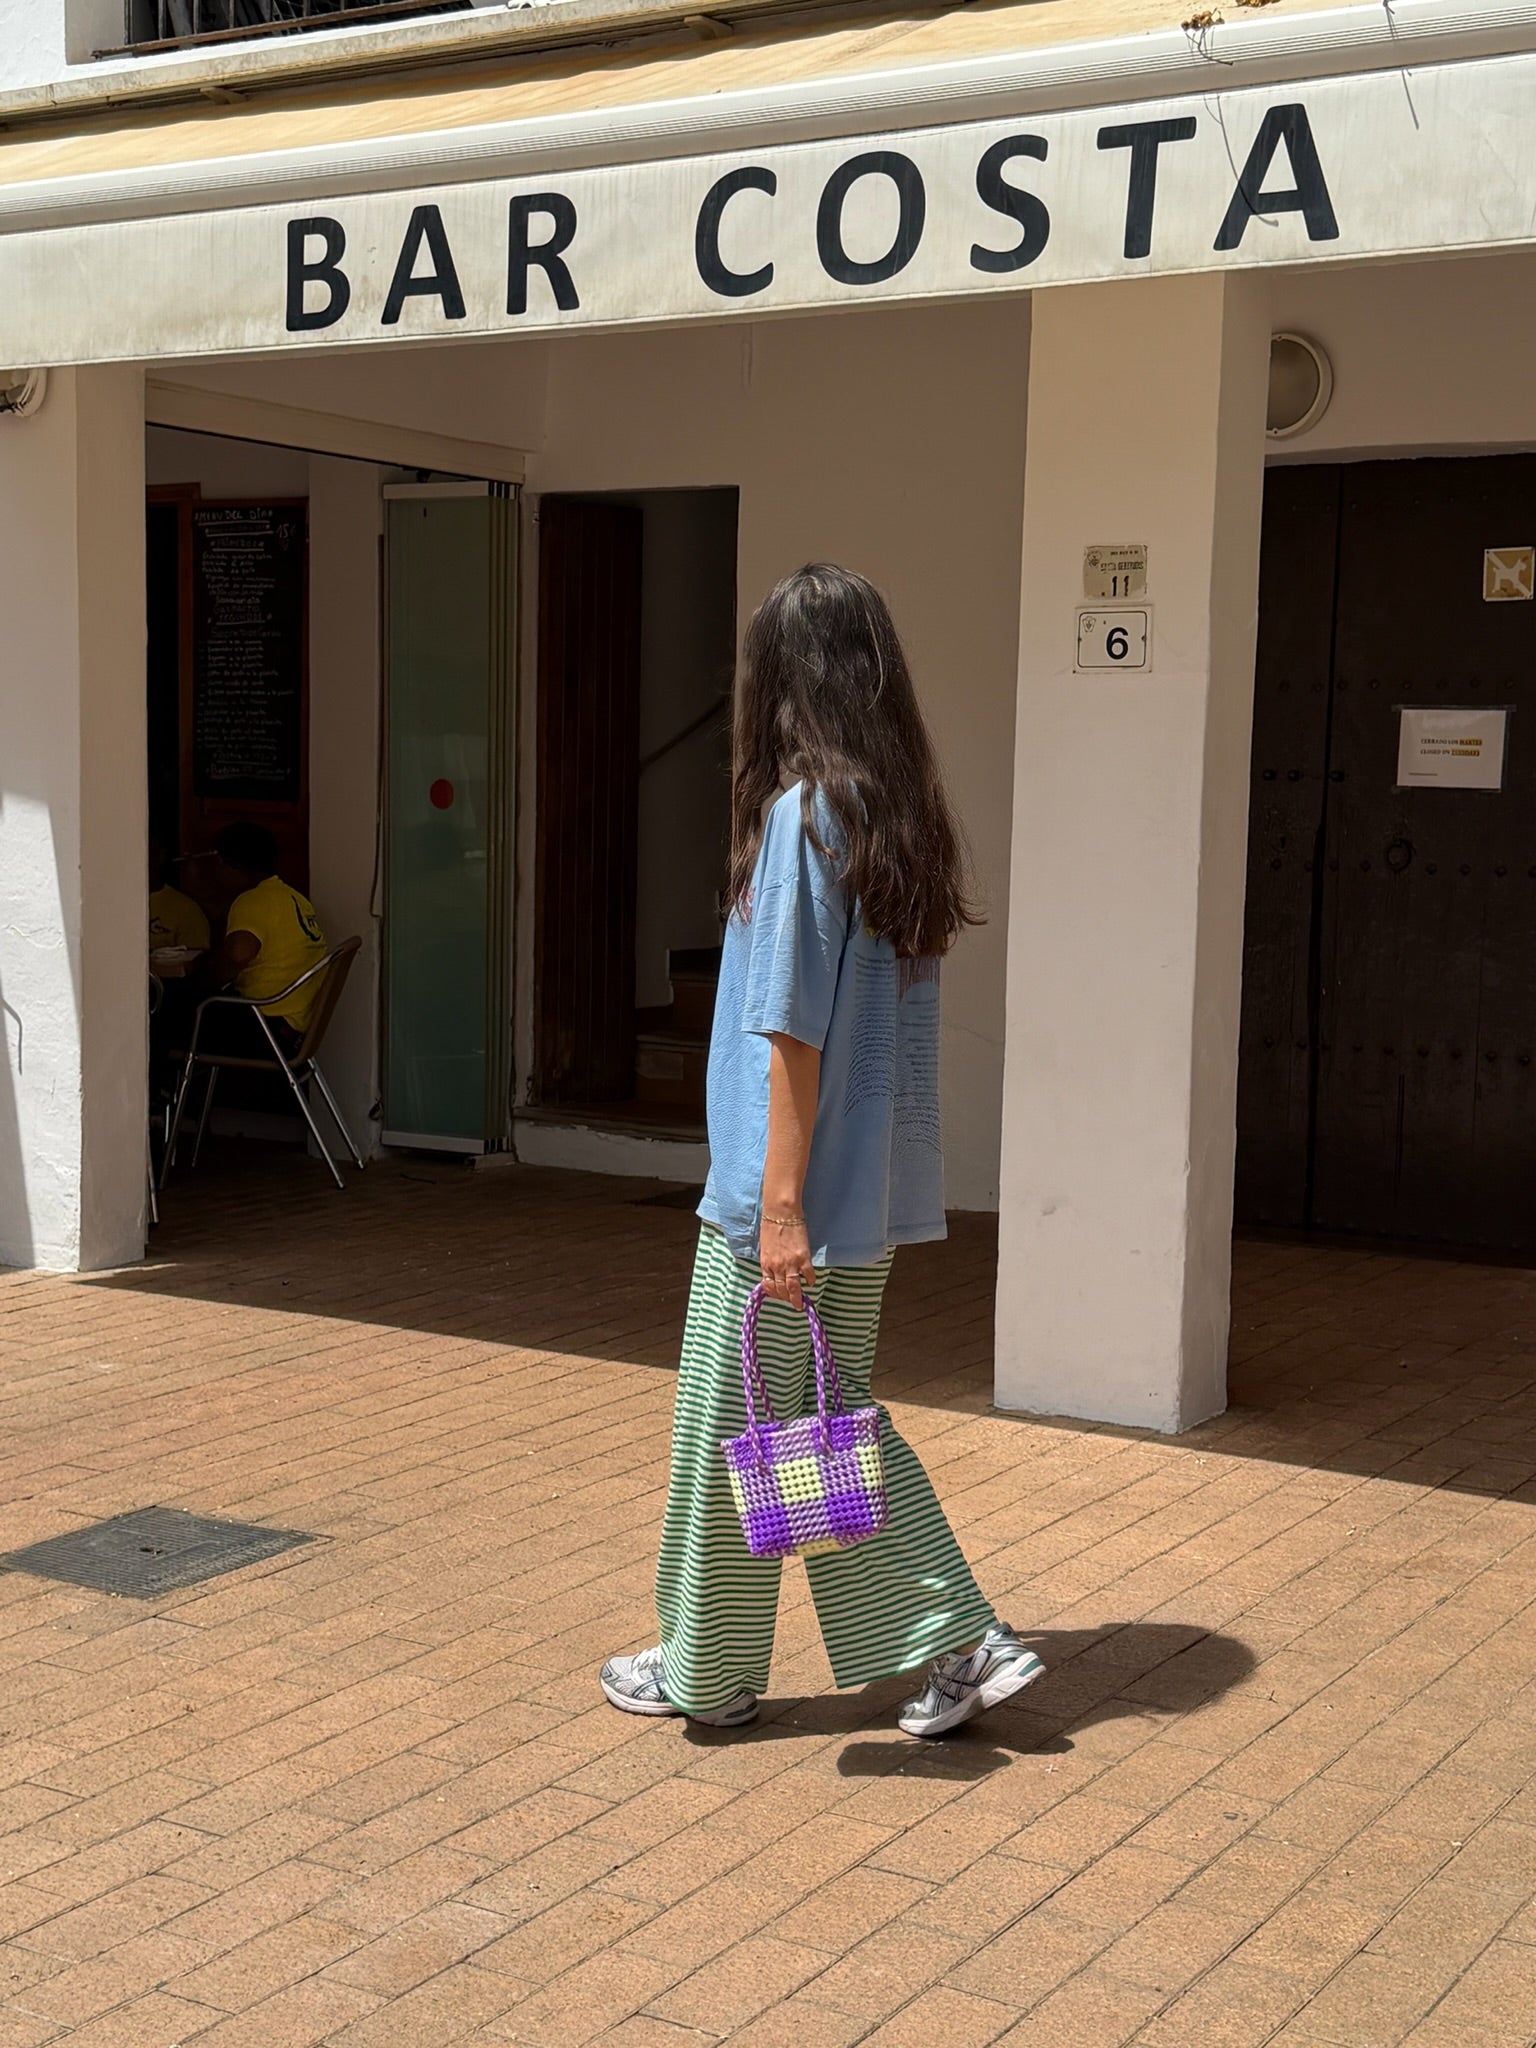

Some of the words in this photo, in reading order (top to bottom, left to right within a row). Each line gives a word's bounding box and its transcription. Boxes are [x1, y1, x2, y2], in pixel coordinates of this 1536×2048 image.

[286, 192, 580, 332] BAR
[694, 103, 1340, 298] COSTA
[225, 510, 243, 520] DEL
[1106, 627, 1129, 660] 6
